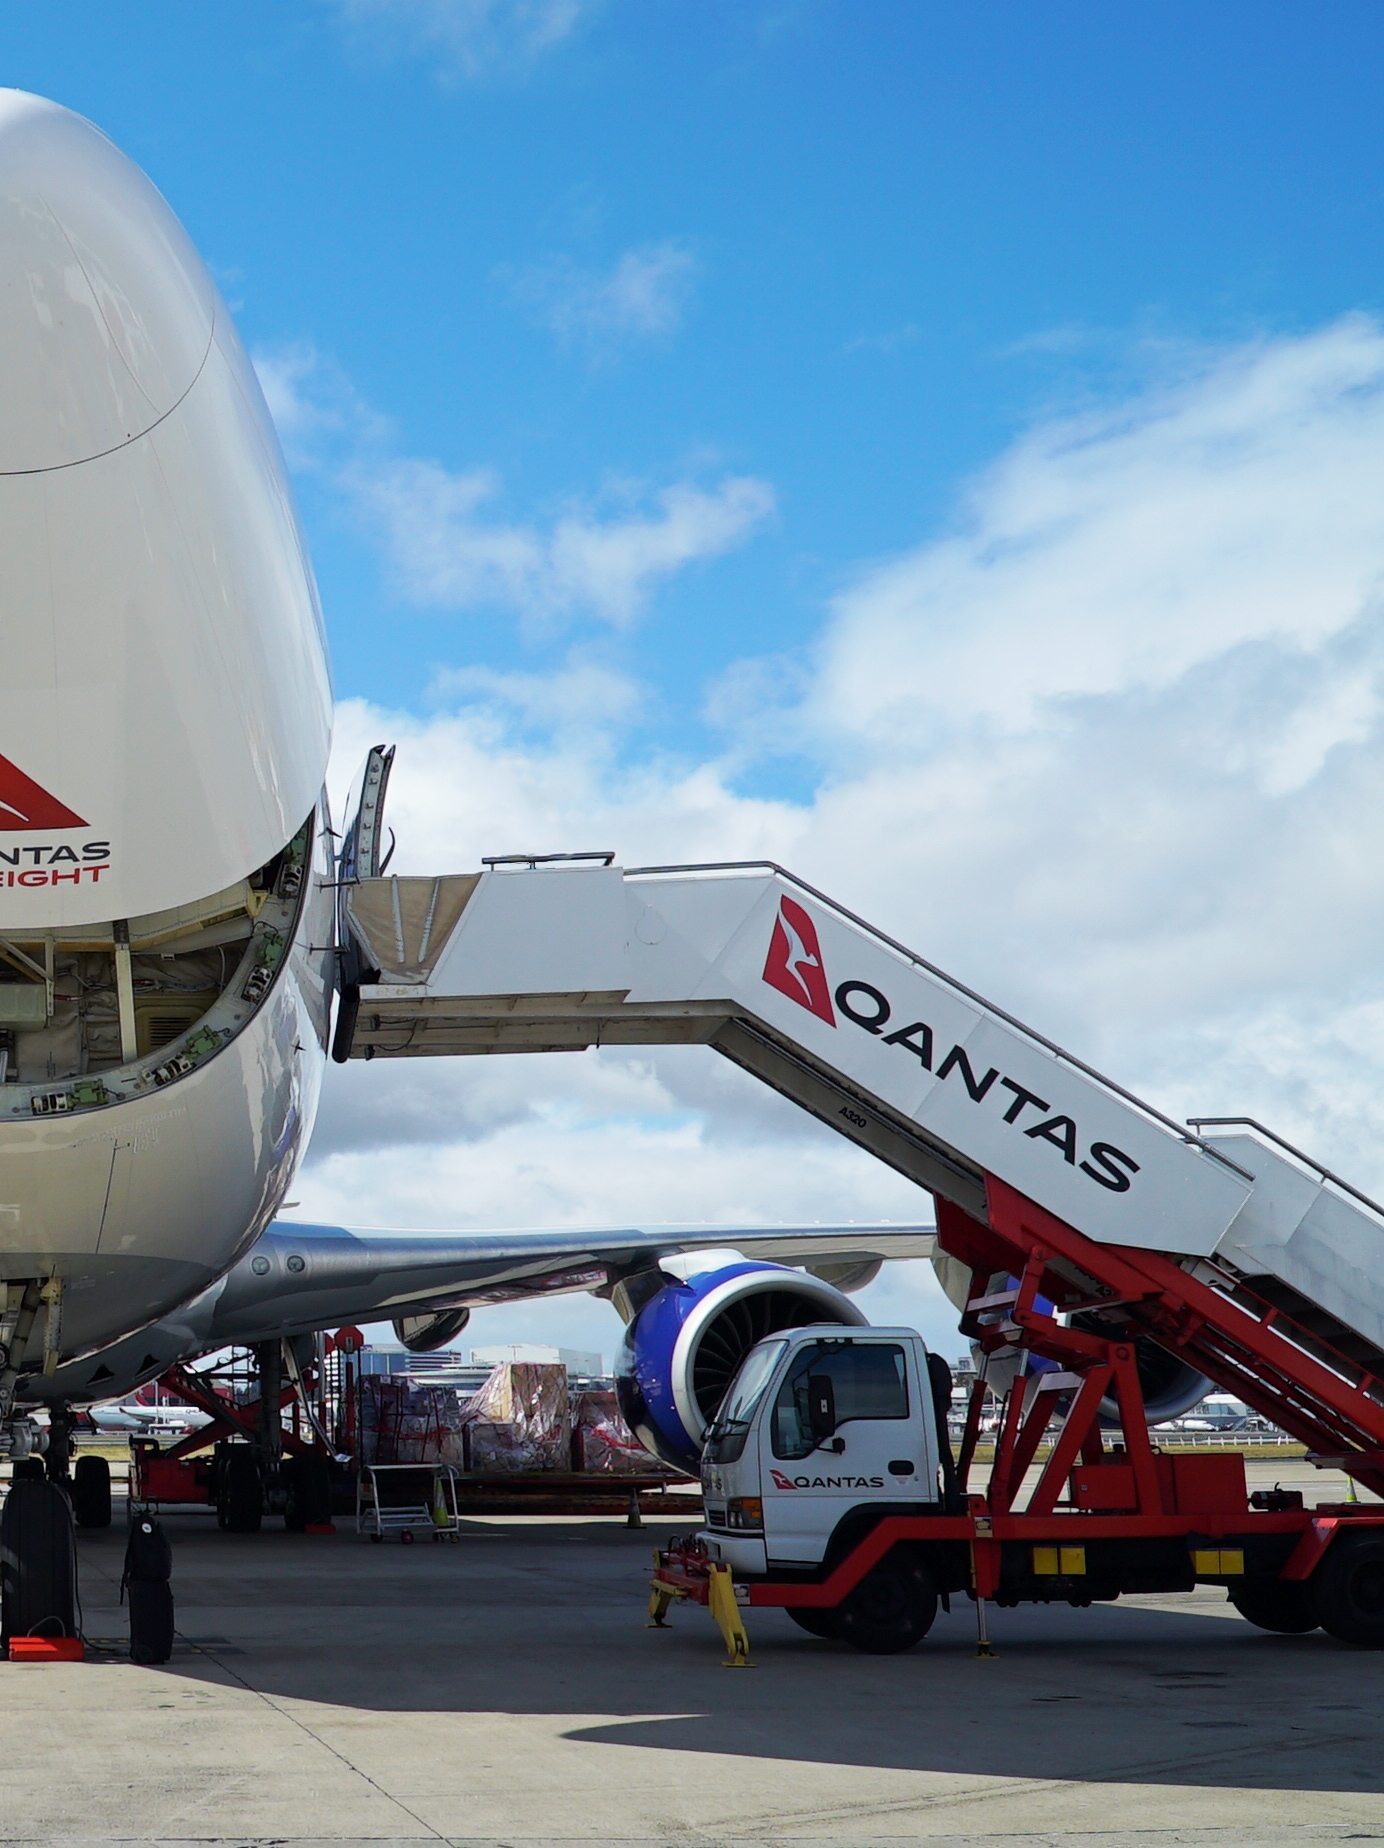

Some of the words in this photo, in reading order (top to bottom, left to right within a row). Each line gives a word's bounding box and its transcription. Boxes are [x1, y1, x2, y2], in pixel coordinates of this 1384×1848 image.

[834, 979, 1141, 1193] QANTAS
[838, 1106, 868, 1128] A320
[793, 1476, 884, 1488] QANTAS
